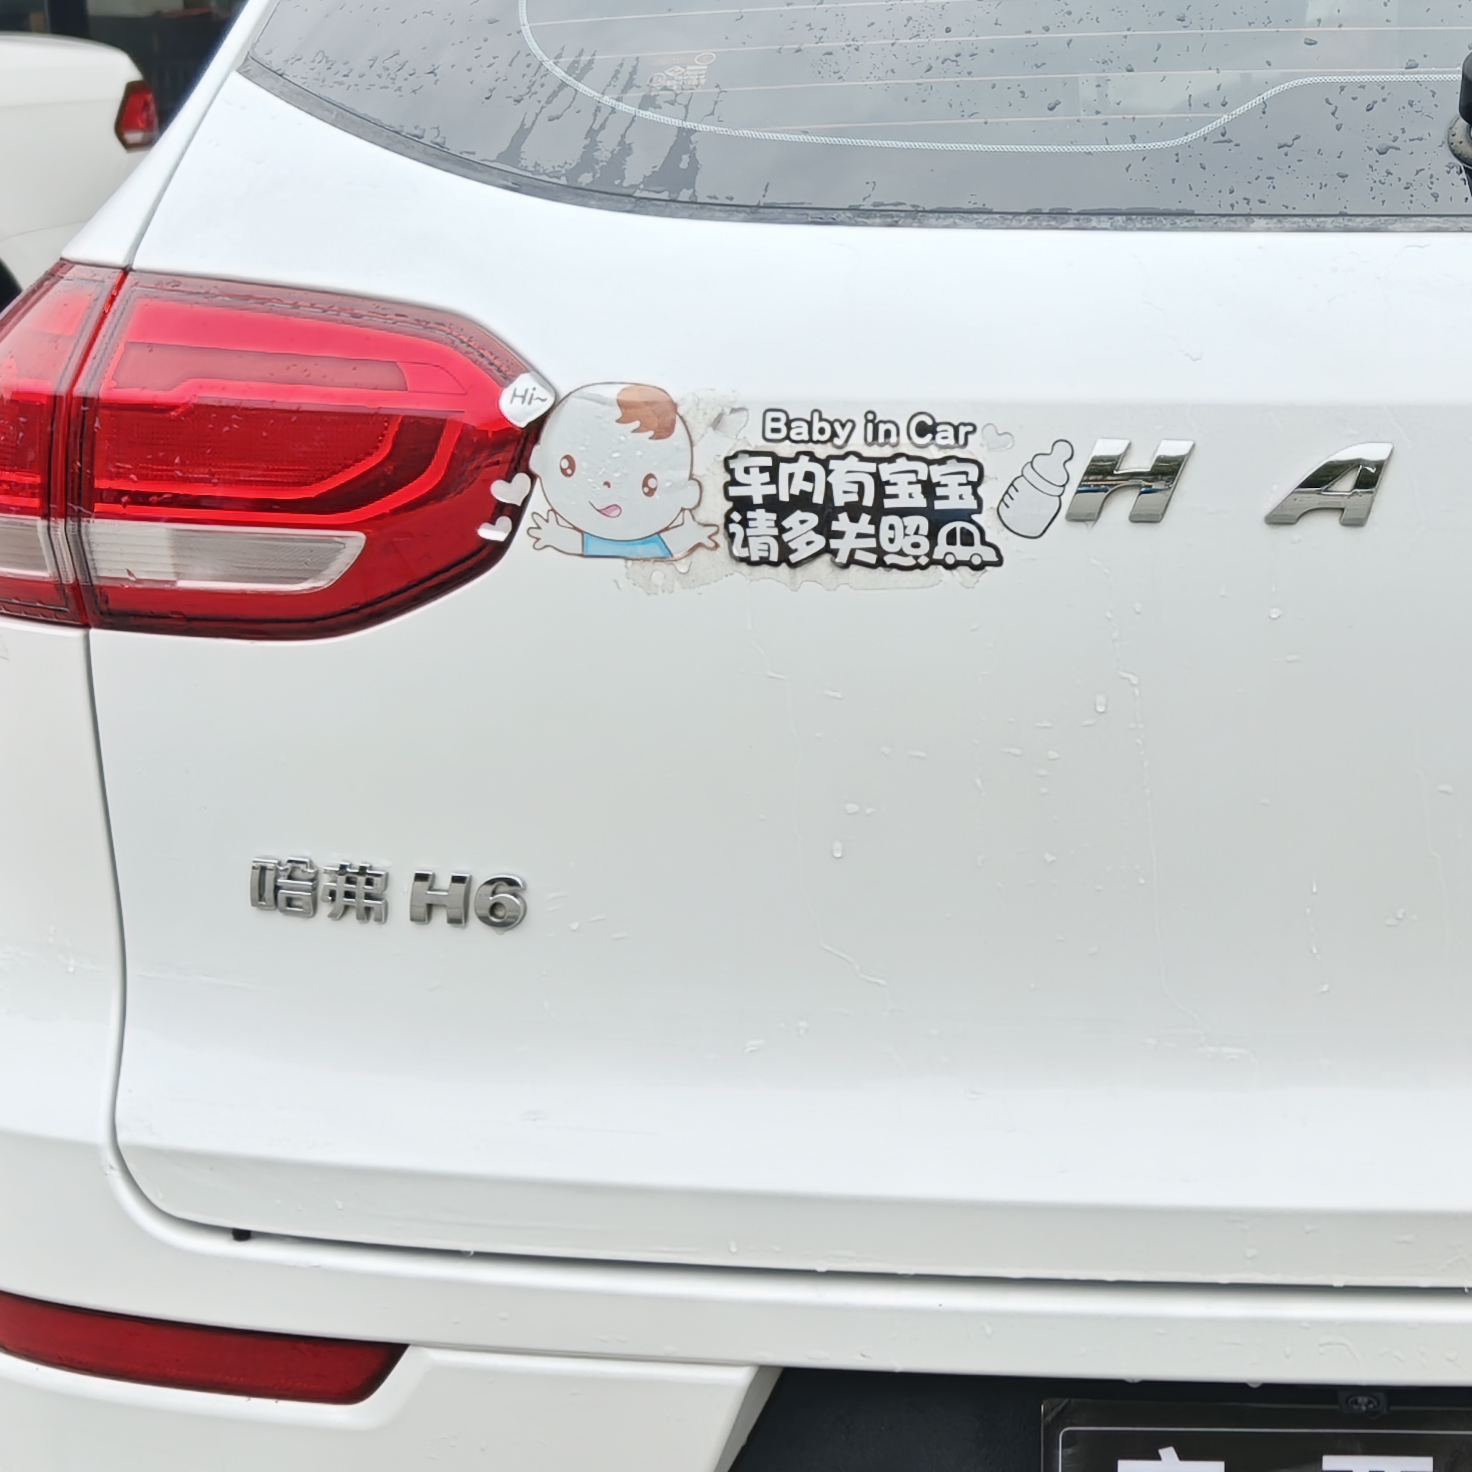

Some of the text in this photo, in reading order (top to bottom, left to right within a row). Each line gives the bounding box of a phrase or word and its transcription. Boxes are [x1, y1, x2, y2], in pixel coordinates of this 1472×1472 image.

[763, 411, 975, 447] Baby in Car
[727, 455, 982, 510] 车内有宝宝
[728, 515, 931, 566] 请多关照
[250, 856, 527, 928] 哈弗 H6
